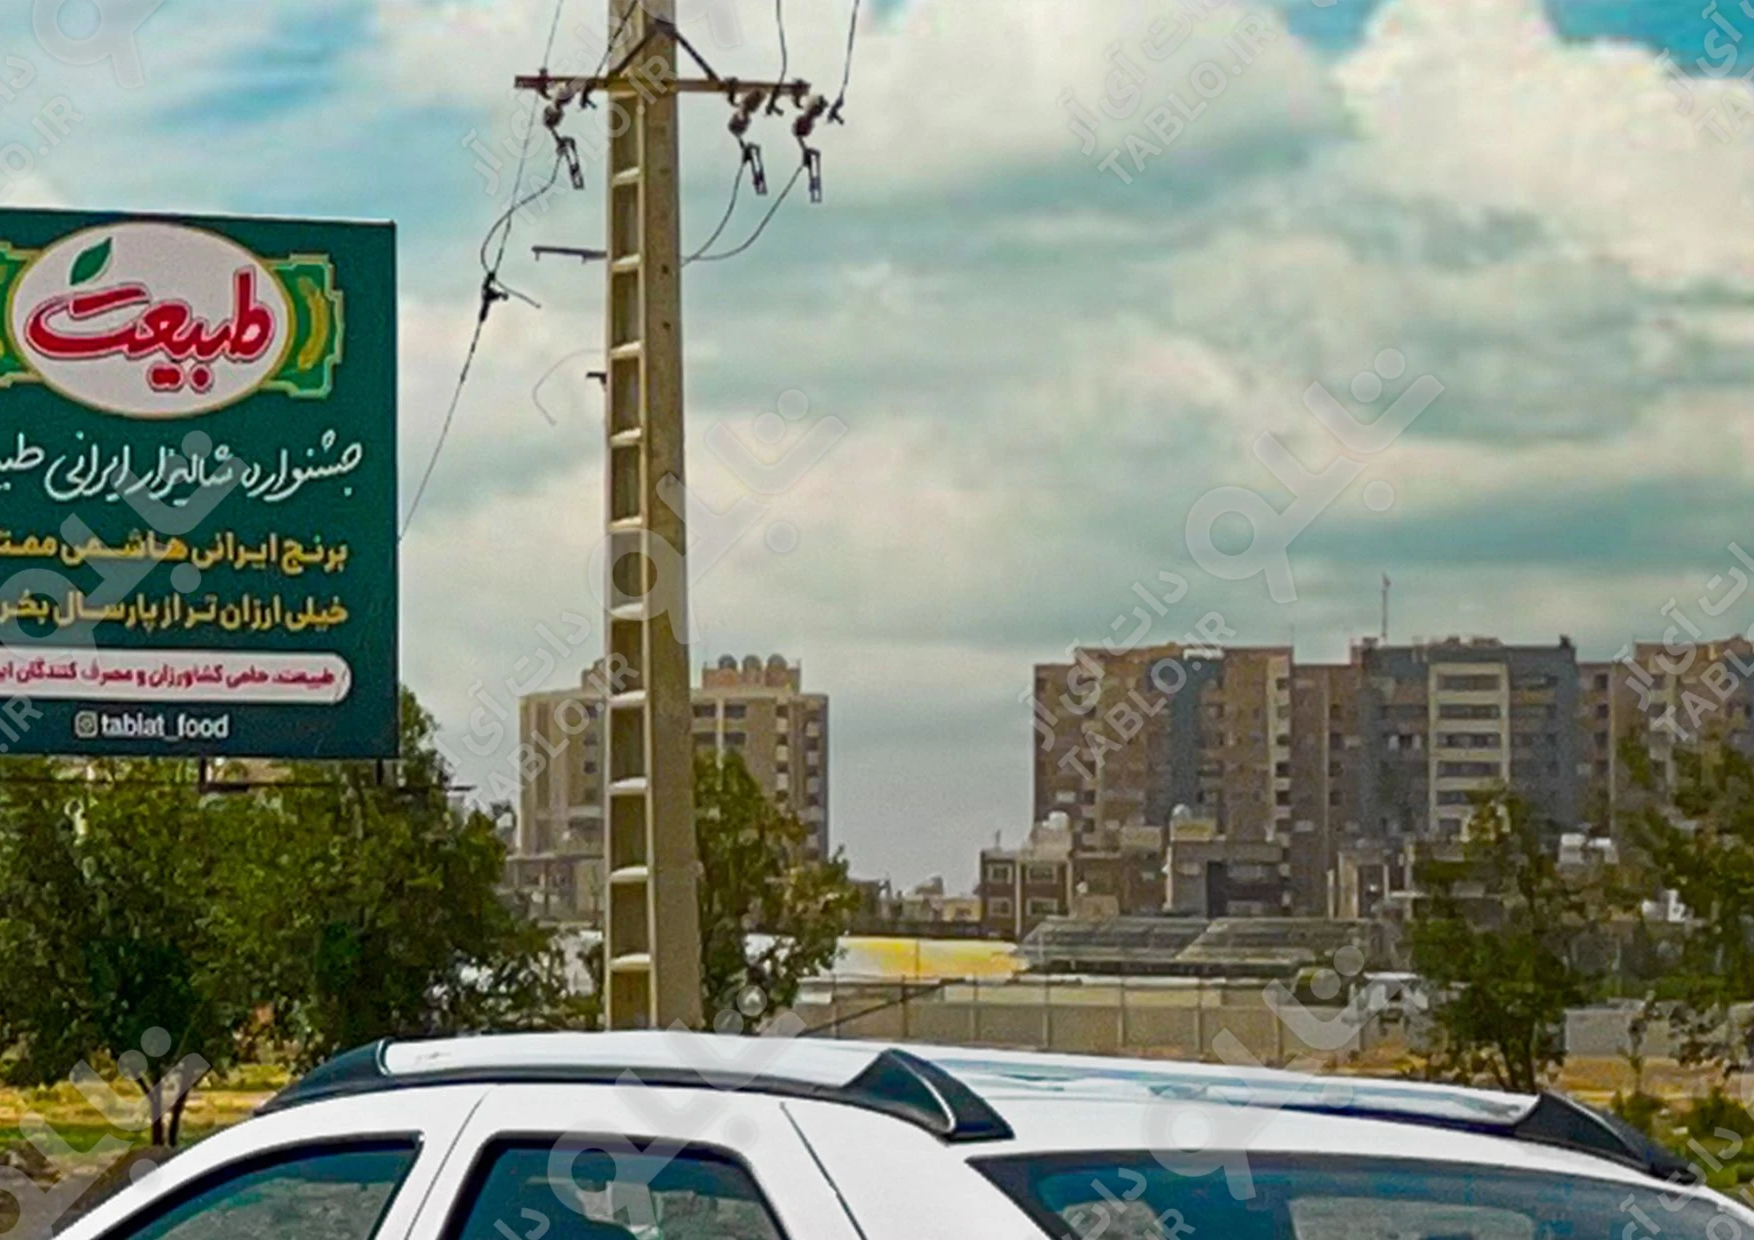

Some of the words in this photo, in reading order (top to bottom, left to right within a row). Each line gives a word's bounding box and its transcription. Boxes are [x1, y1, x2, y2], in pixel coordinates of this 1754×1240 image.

[25, 264, 275, 393] طبیعت
[44, 430, 130, 502] ایرانی
[123, 443, 236, 507] شالیزار
[240, 428, 363, 503] جشنواره
[59, 527, 189, 567] هاشمی
[190, 531, 278, 570] ایرانی
[280, 534, 349, 576] برنج
[52, 588, 158, 633] پارسال
[159, 591, 181, 630] از
[183, 593, 219, 630] تر
[219, 592, 282, 631] ارزان
[283, 594, 350, 633] خیلی
[16, 656, 79, 684] کنندگان
[148, 663, 224, 690] کشاورزان
